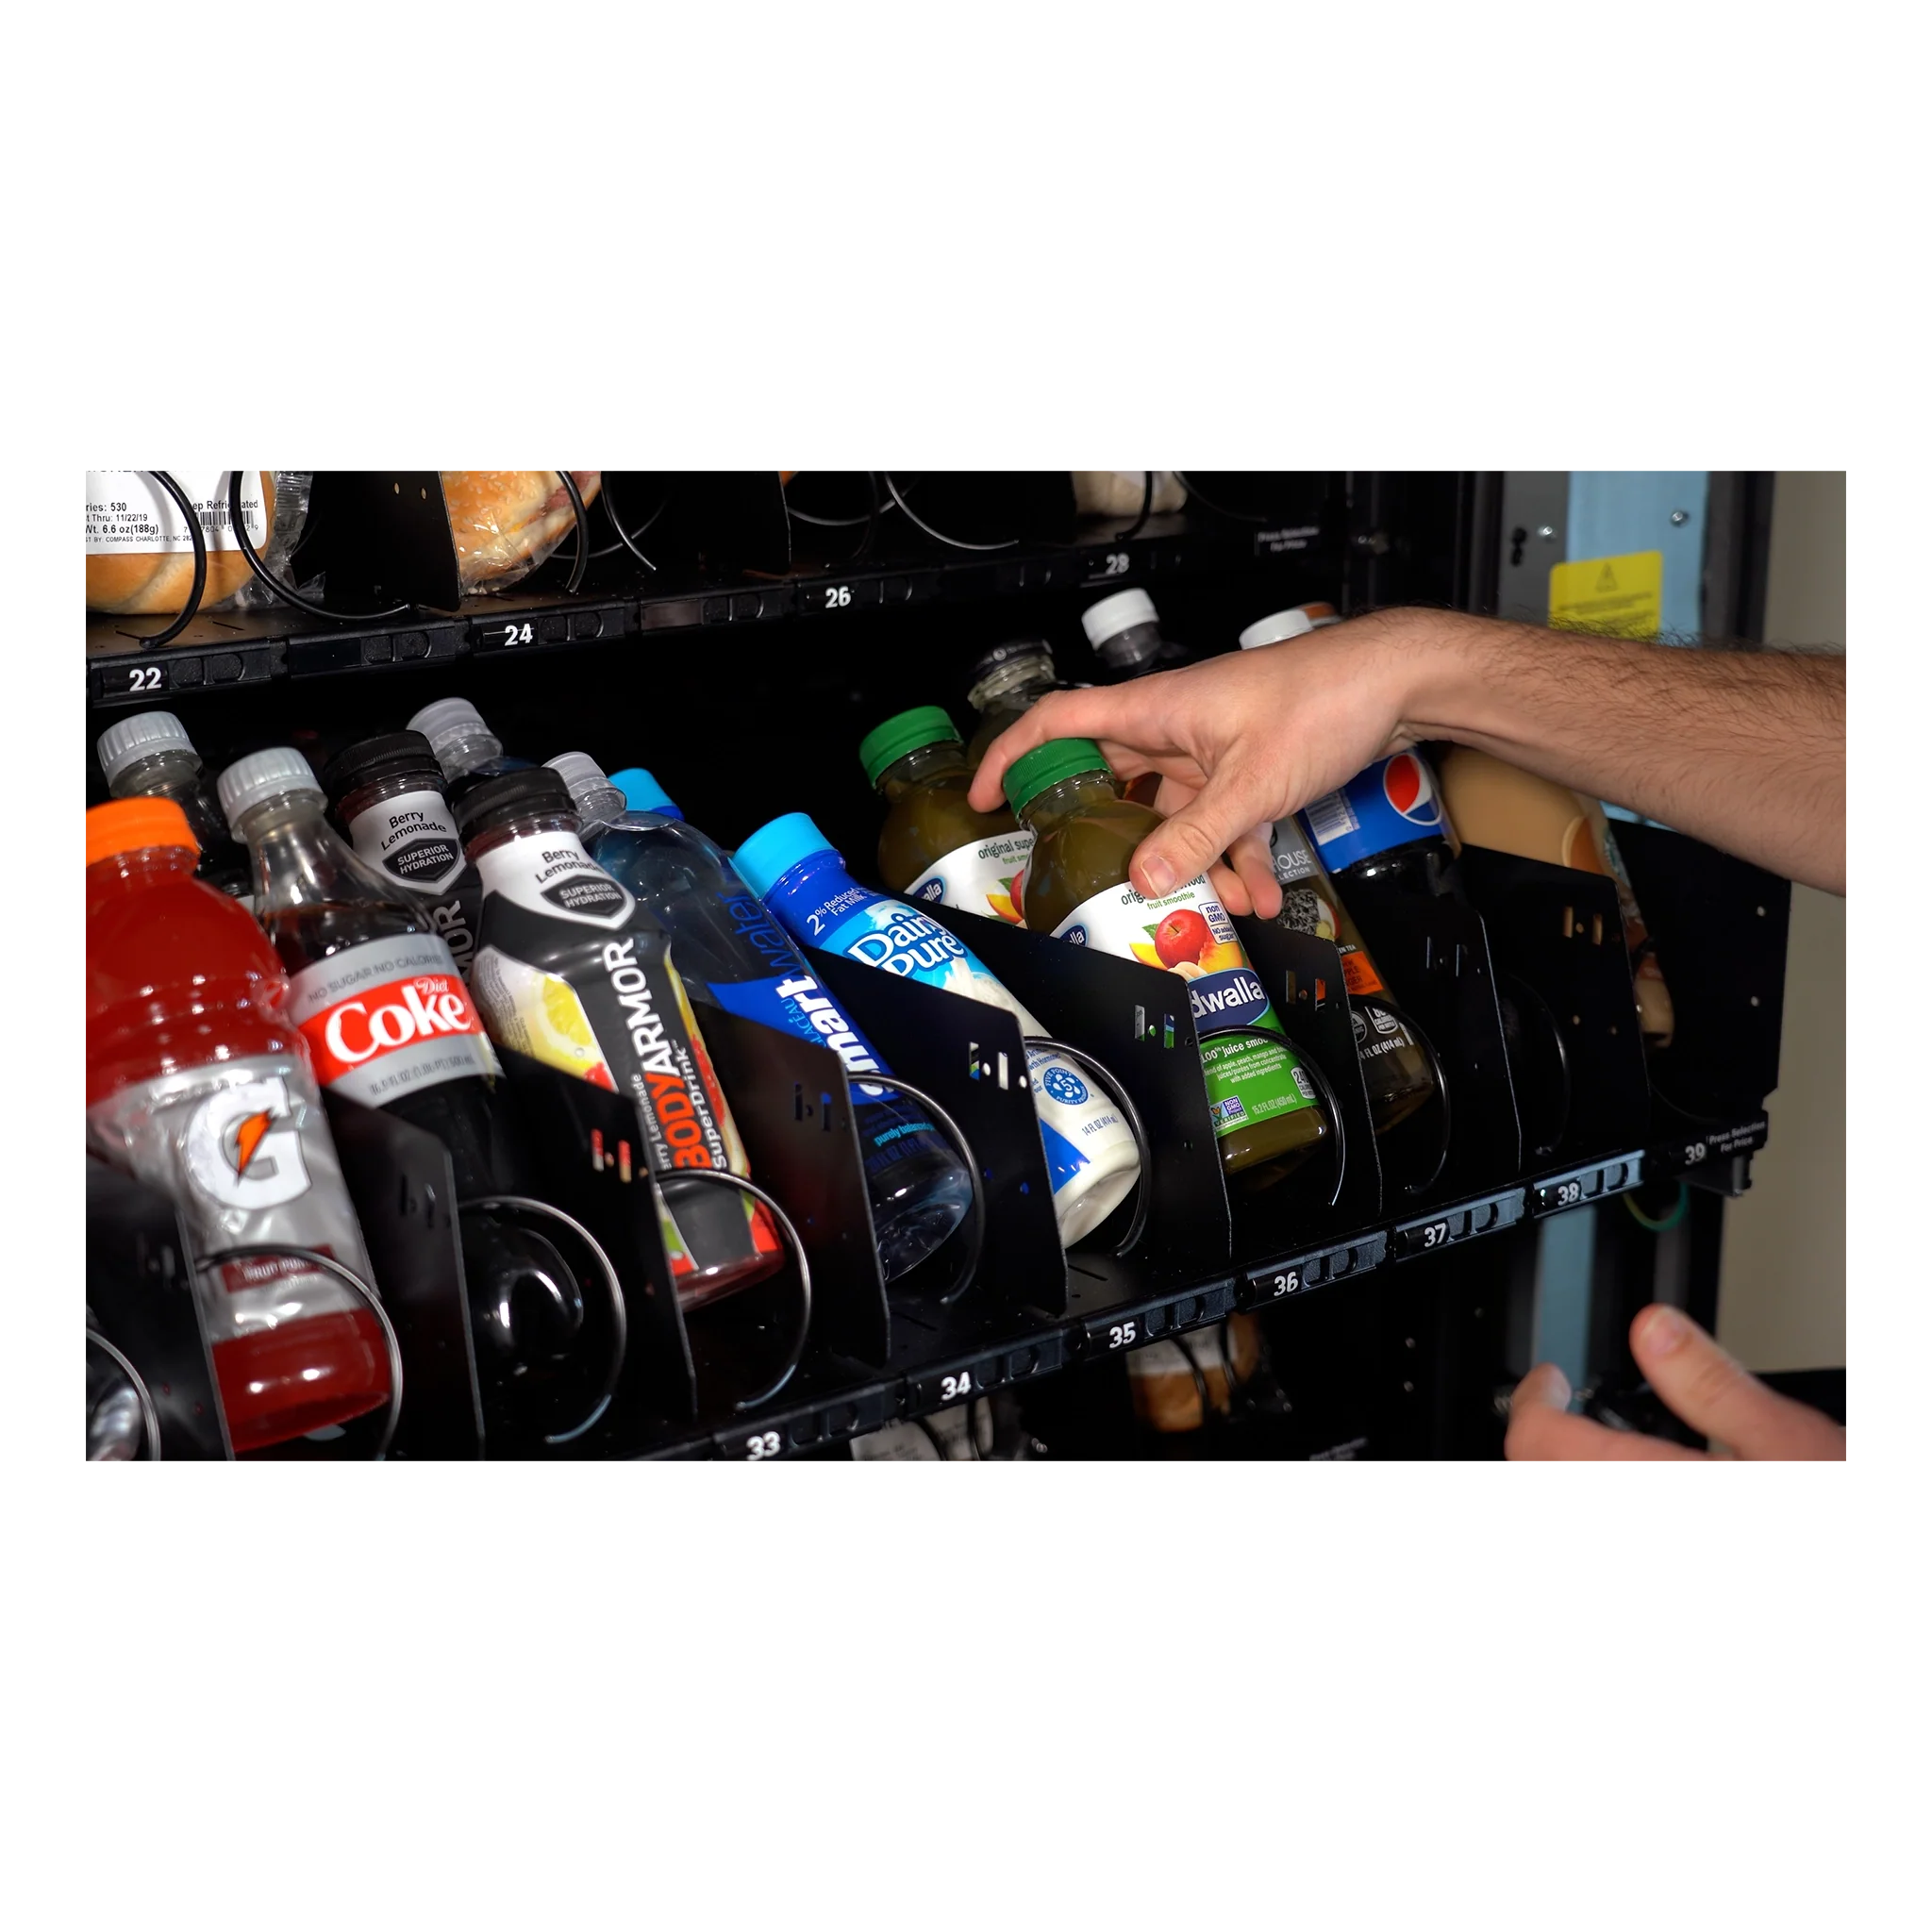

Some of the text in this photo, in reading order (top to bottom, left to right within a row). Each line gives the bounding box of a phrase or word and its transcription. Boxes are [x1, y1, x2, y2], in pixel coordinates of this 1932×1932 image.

[110, 502, 127, 512] 530
[192, 500, 258, 512] ep Refriated
[92, 514, 113, 523] Thru:
[116, 513, 148, 523] 11/22/19
[102, 525, 117, 534] 6.6
[119, 524, 159, 536] oz(188g)
[1106, 554, 1129, 574] 28
[825, 587, 851, 608] 26
[504, 624, 533, 646] 24
[128, 667, 162, 691] 22
[389, 811, 425, 829] Berry
[380, 822, 447, 851] Lemonade
[397, 844, 450, 866] SUPERIOR
[541, 849, 580, 864] Berry
[978, 840, 1015, 859] original
[399, 852, 454, 874] HYDRATION
[1278, 866, 1311, 880] LECTION
[558, 883, 615, 900] SUPERIOR
[563, 892, 623, 908] HYDRATION
[921, 883, 942, 902] alla
[1121, 889, 1146, 906] orig
[1146, 891, 1196, 910] fruit smoothie
[807, 907, 827, 937] 2%
[824, 887, 860, 912] Reduced
[830, 902, 849, 917] Fat
[1206, 905, 1221, 914] non
[1208, 912, 1225, 923] GMO
[848, 914, 947, 968] Dairy
[881, 933, 965, 977] Pure
[308, 987, 328, 1003] NO
[375, 961, 395, 974] NO
[413, 977, 450, 994] Diet
[1191, 976, 1266, 1018] dwalla
[325, 984, 473, 1064] Coke
[601, 937, 713, 1170] BODYARMOR
[1221, 1042, 1245, 1058] juice
[1252, 1051, 1269, 1060] mango
[1364, 1047, 1374, 1058] FL
[1372, 1043, 1383, 1055] OZ
[1380, 1039, 1395, 1054] (414
[1230, 1063, 1282, 1084] with added ingredients
[1060, 1079, 1074, 1091] 5
[1224, 1097, 1239, 1107] NON
[1226, 1102, 1241, 1111] GMO
[631, 1073, 673, 1170] erry Lemonade
[1081, 1126, 1091, 1136] 14
[185, 1076, 312, 1210] G
[1685, 1142, 1706, 1165] 39
[1557, 1182, 1580, 1206] 38
[1424, 1224, 1447, 1248] 37
[1274, 1271, 1299, 1297] 36
[1108, 1323, 1136, 1349] 35
[941, 1373, 972, 1401] 34
[746, 1431, 781, 1462] 33
